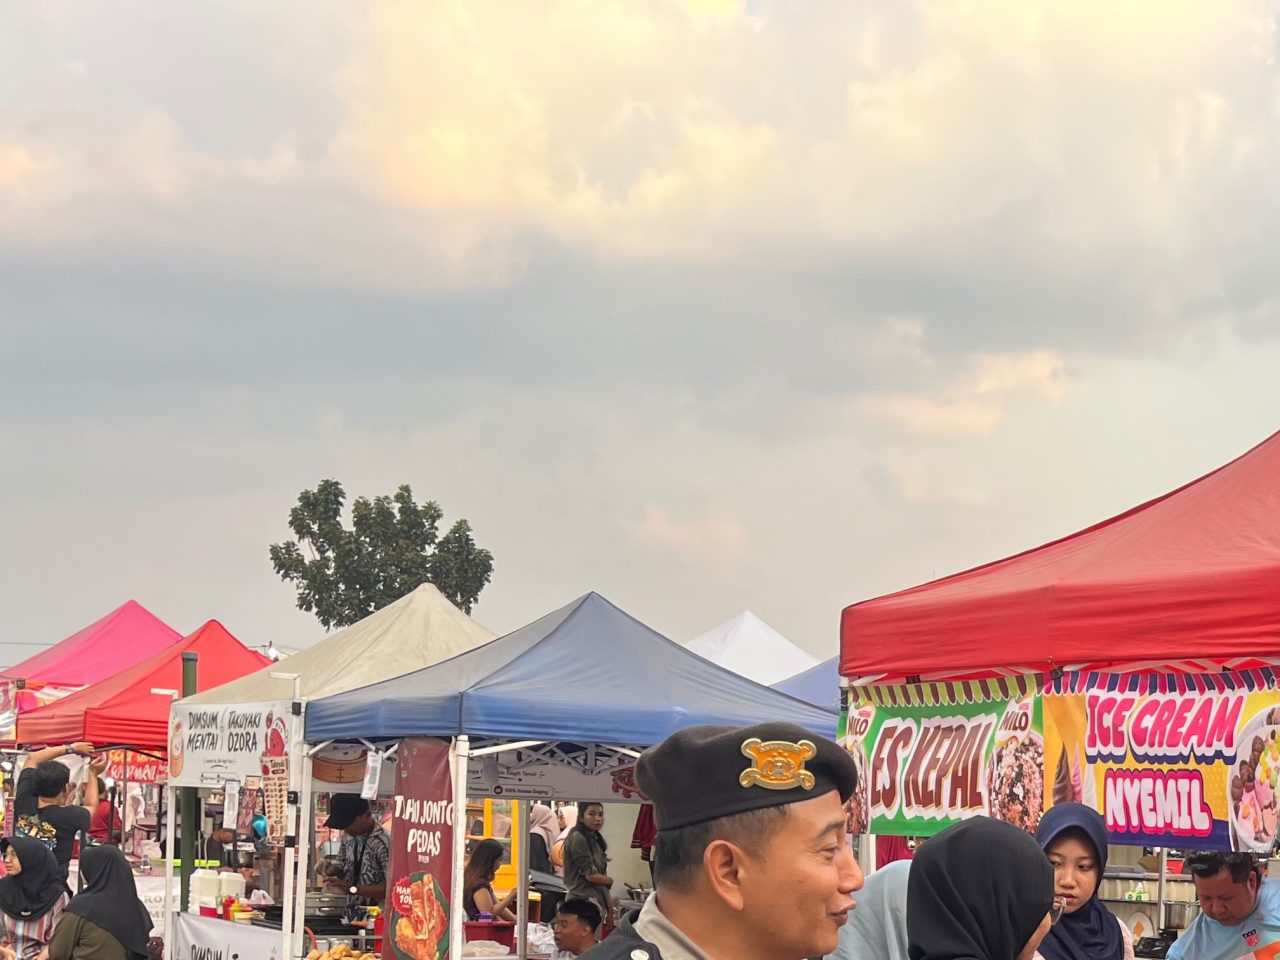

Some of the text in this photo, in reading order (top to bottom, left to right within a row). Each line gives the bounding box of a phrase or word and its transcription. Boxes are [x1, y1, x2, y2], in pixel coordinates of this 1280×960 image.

[188, 710, 262, 731] DIMSUM TAKOYAKI
[999, 710, 1029, 731] MILO
[1087, 694, 1244, 749] ICE CREAM
[187, 731, 258, 753] MENTAI OZORA
[870, 720, 993, 811] ES KEPAL
[1106, 777, 1211, 831] NYEMIL
[407, 828, 441, 857] PEDAS
